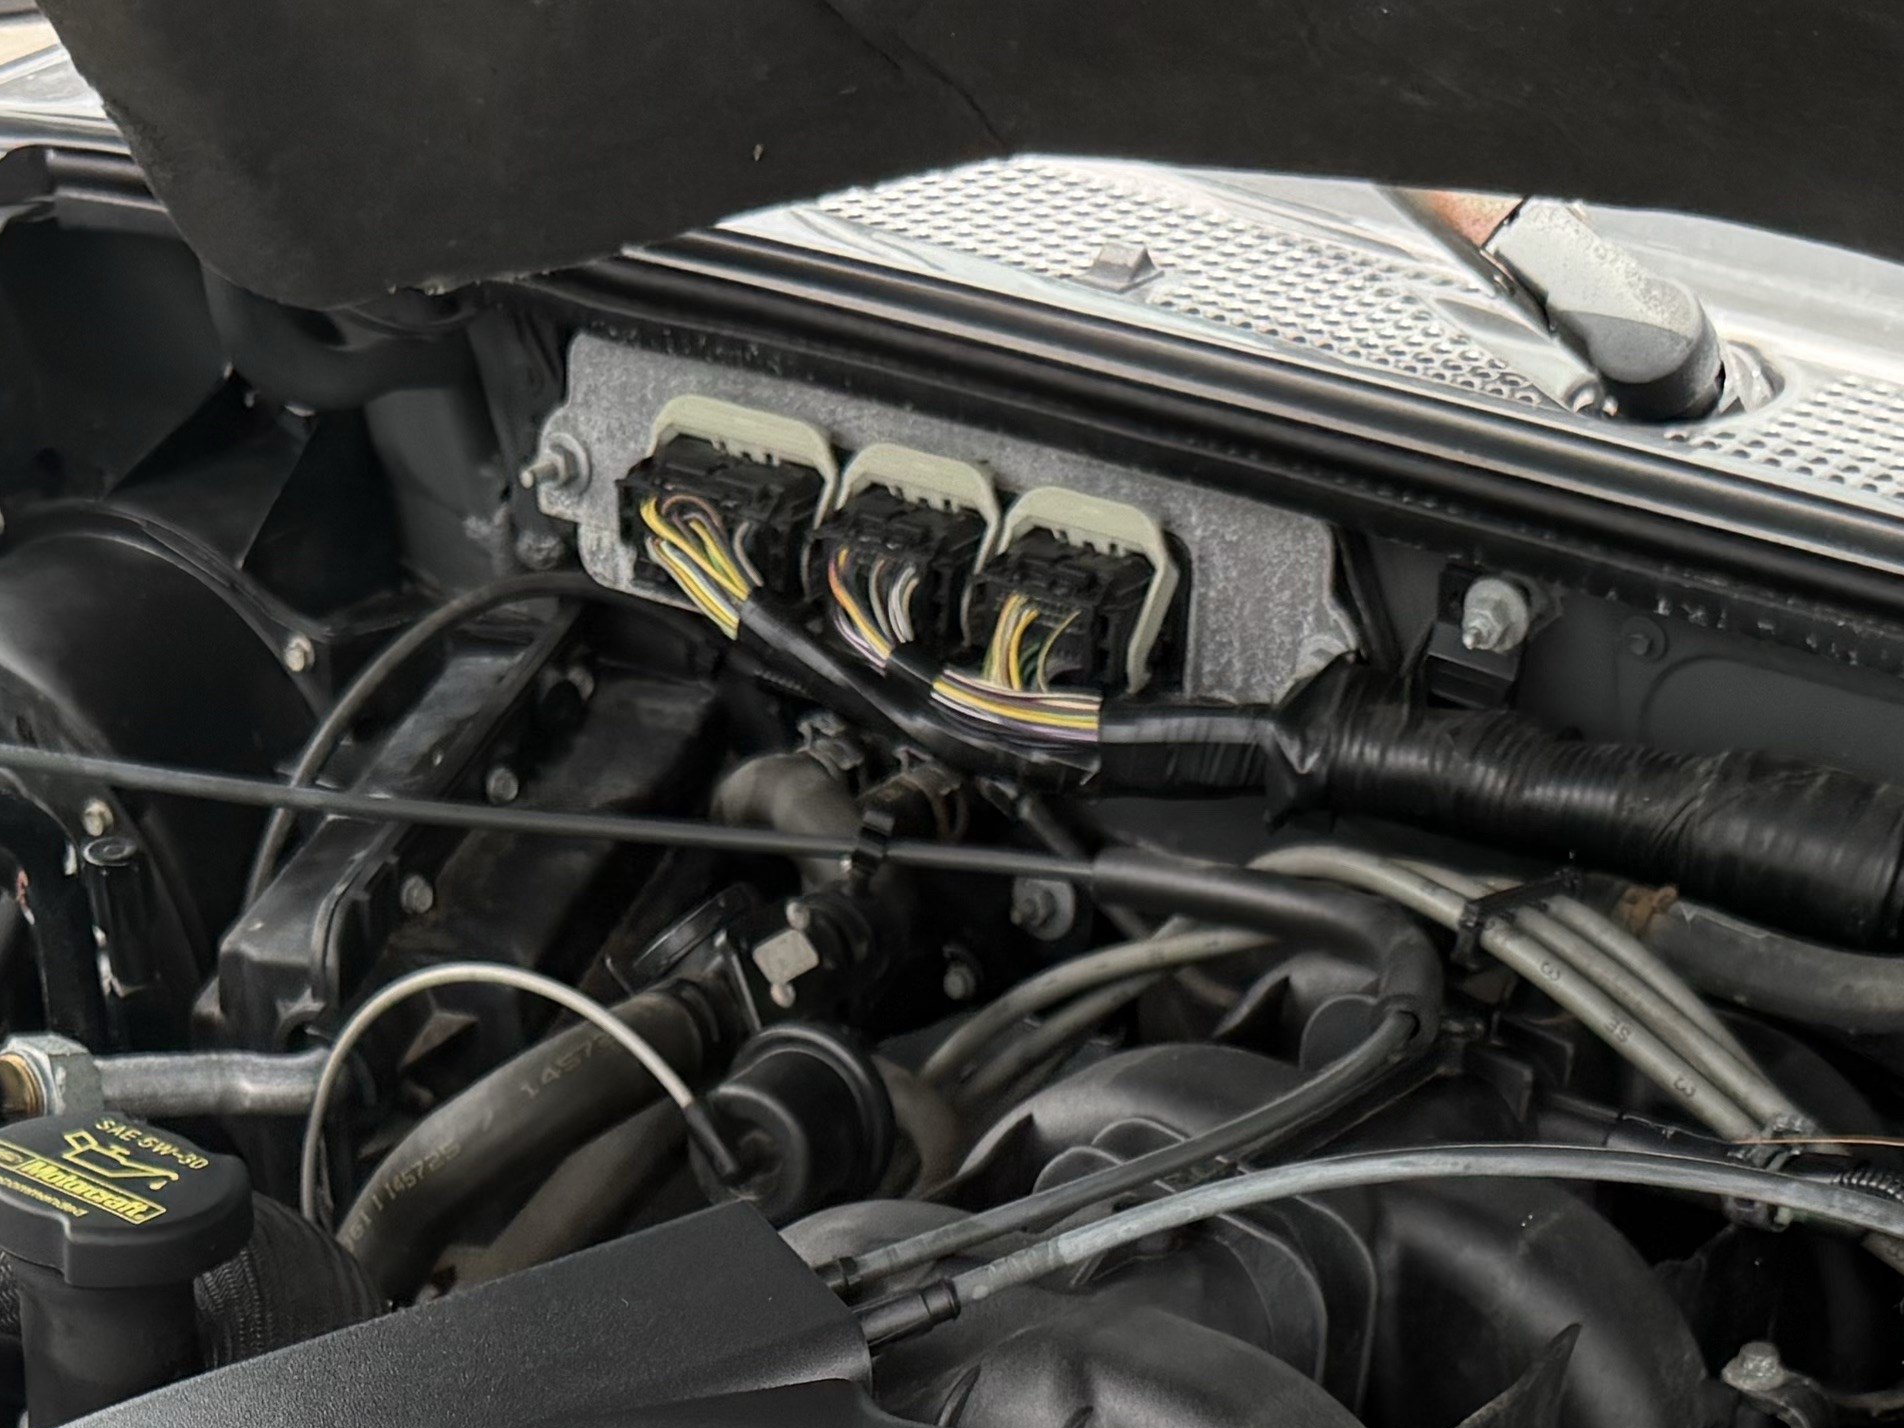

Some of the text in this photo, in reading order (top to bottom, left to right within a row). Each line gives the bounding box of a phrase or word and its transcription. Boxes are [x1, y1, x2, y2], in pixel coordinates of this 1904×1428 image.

[96, 1120, 209, 1170] SAE 5W-30
[21, 1159, 150, 1219] Motorcraft
